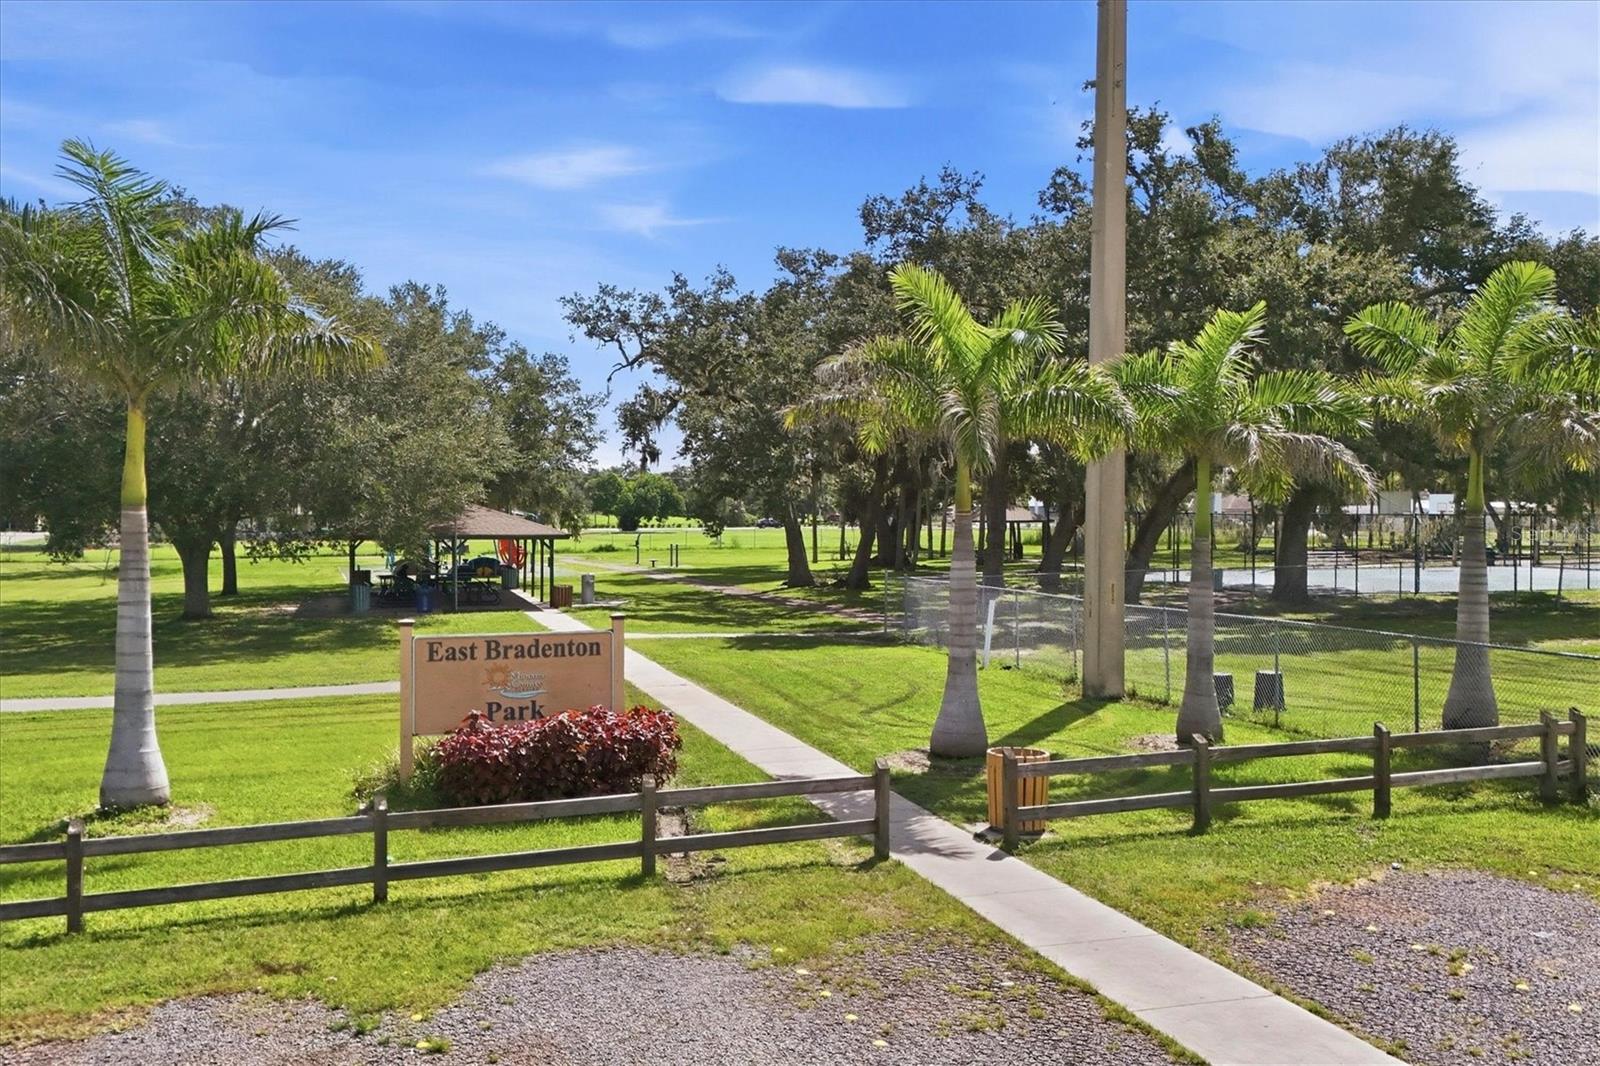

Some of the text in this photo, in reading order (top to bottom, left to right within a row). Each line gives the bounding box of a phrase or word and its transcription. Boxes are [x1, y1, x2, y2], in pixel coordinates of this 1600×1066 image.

[427, 638, 601, 662] East Bradenton
[486, 700, 545, 722] Park
